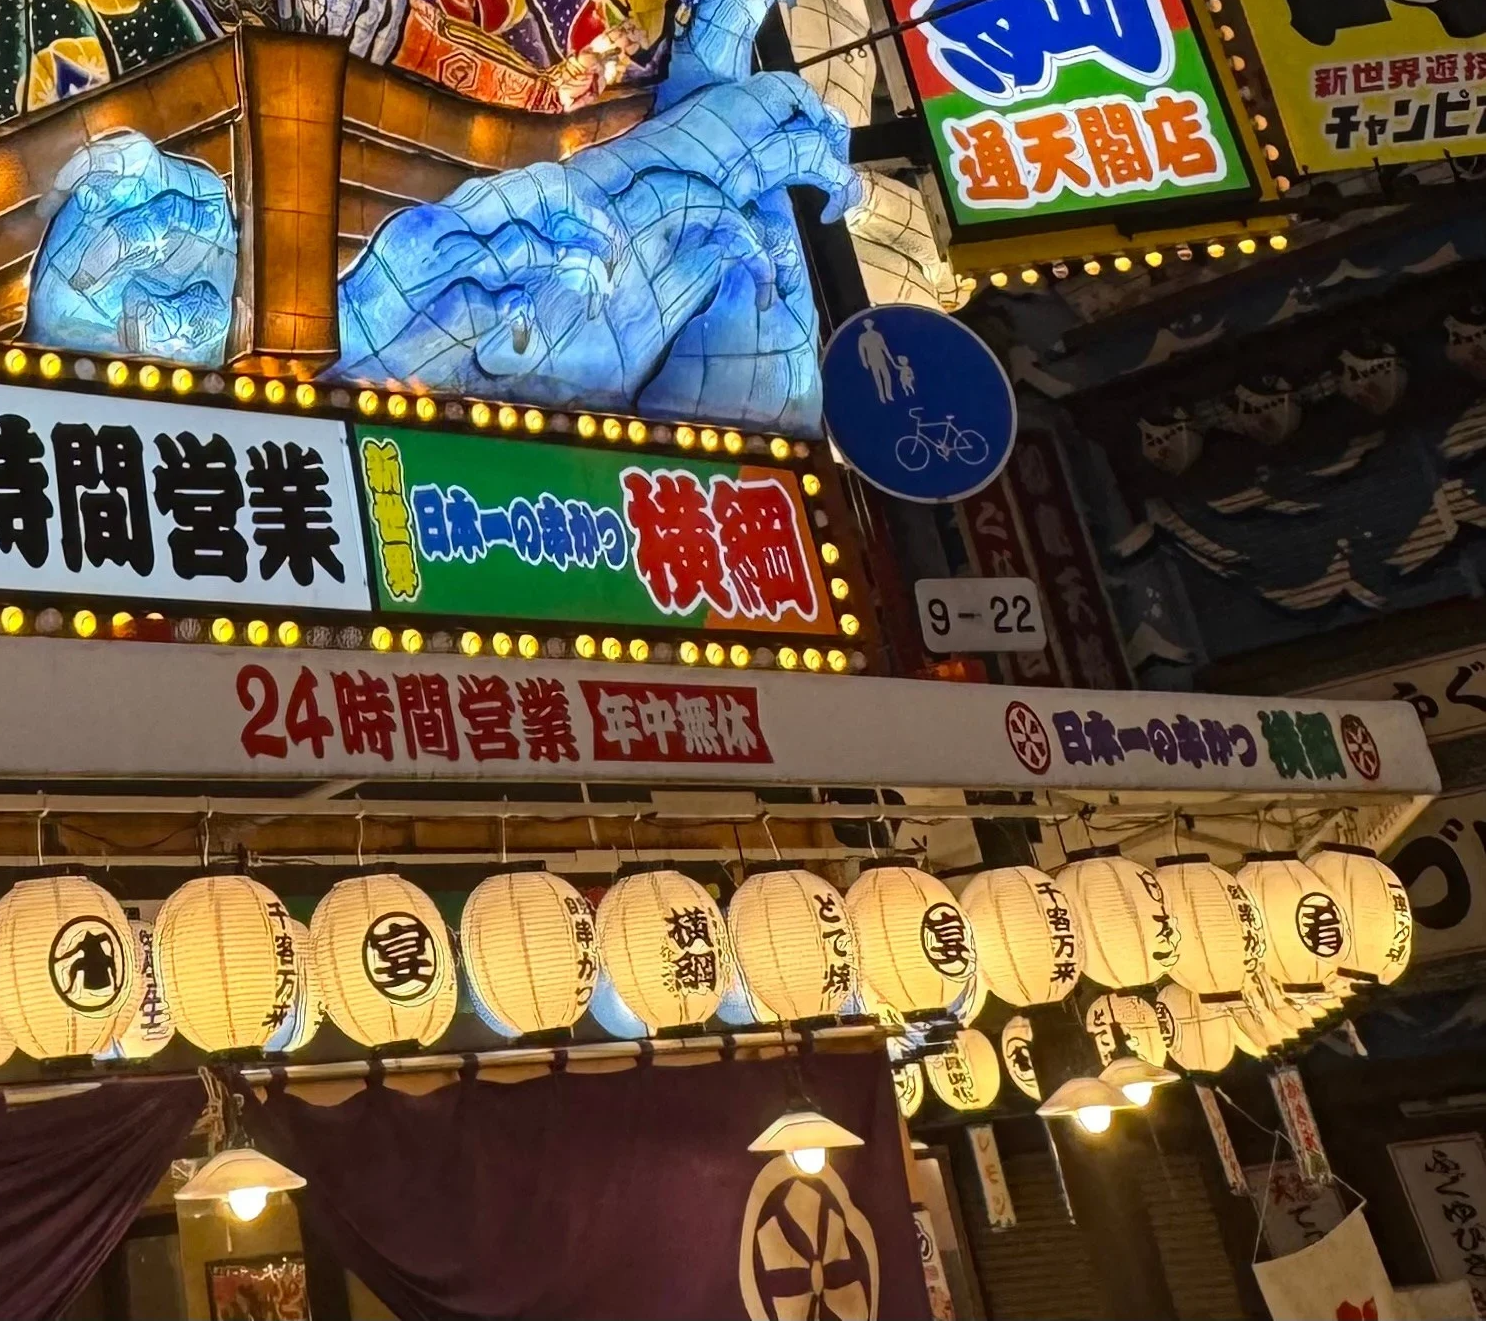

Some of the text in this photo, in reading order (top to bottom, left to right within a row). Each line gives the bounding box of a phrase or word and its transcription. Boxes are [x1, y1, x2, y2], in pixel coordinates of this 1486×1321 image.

[950, 96, 1218, 200] 通天閣店
[413, 471, 814, 617] 日本一の串かつ 横綱
[236, 664, 758, 763] 24時間営業 年中無休
[1052, 709, 1348, 780] 日本一の串かつ 横綱
[1392, 817, 1486, 931] づ
[262, 901, 299, 1030] 千客万来
[664, 905, 717, 992] 横綱
[1035, 881, 1077, 983] 千客万来
